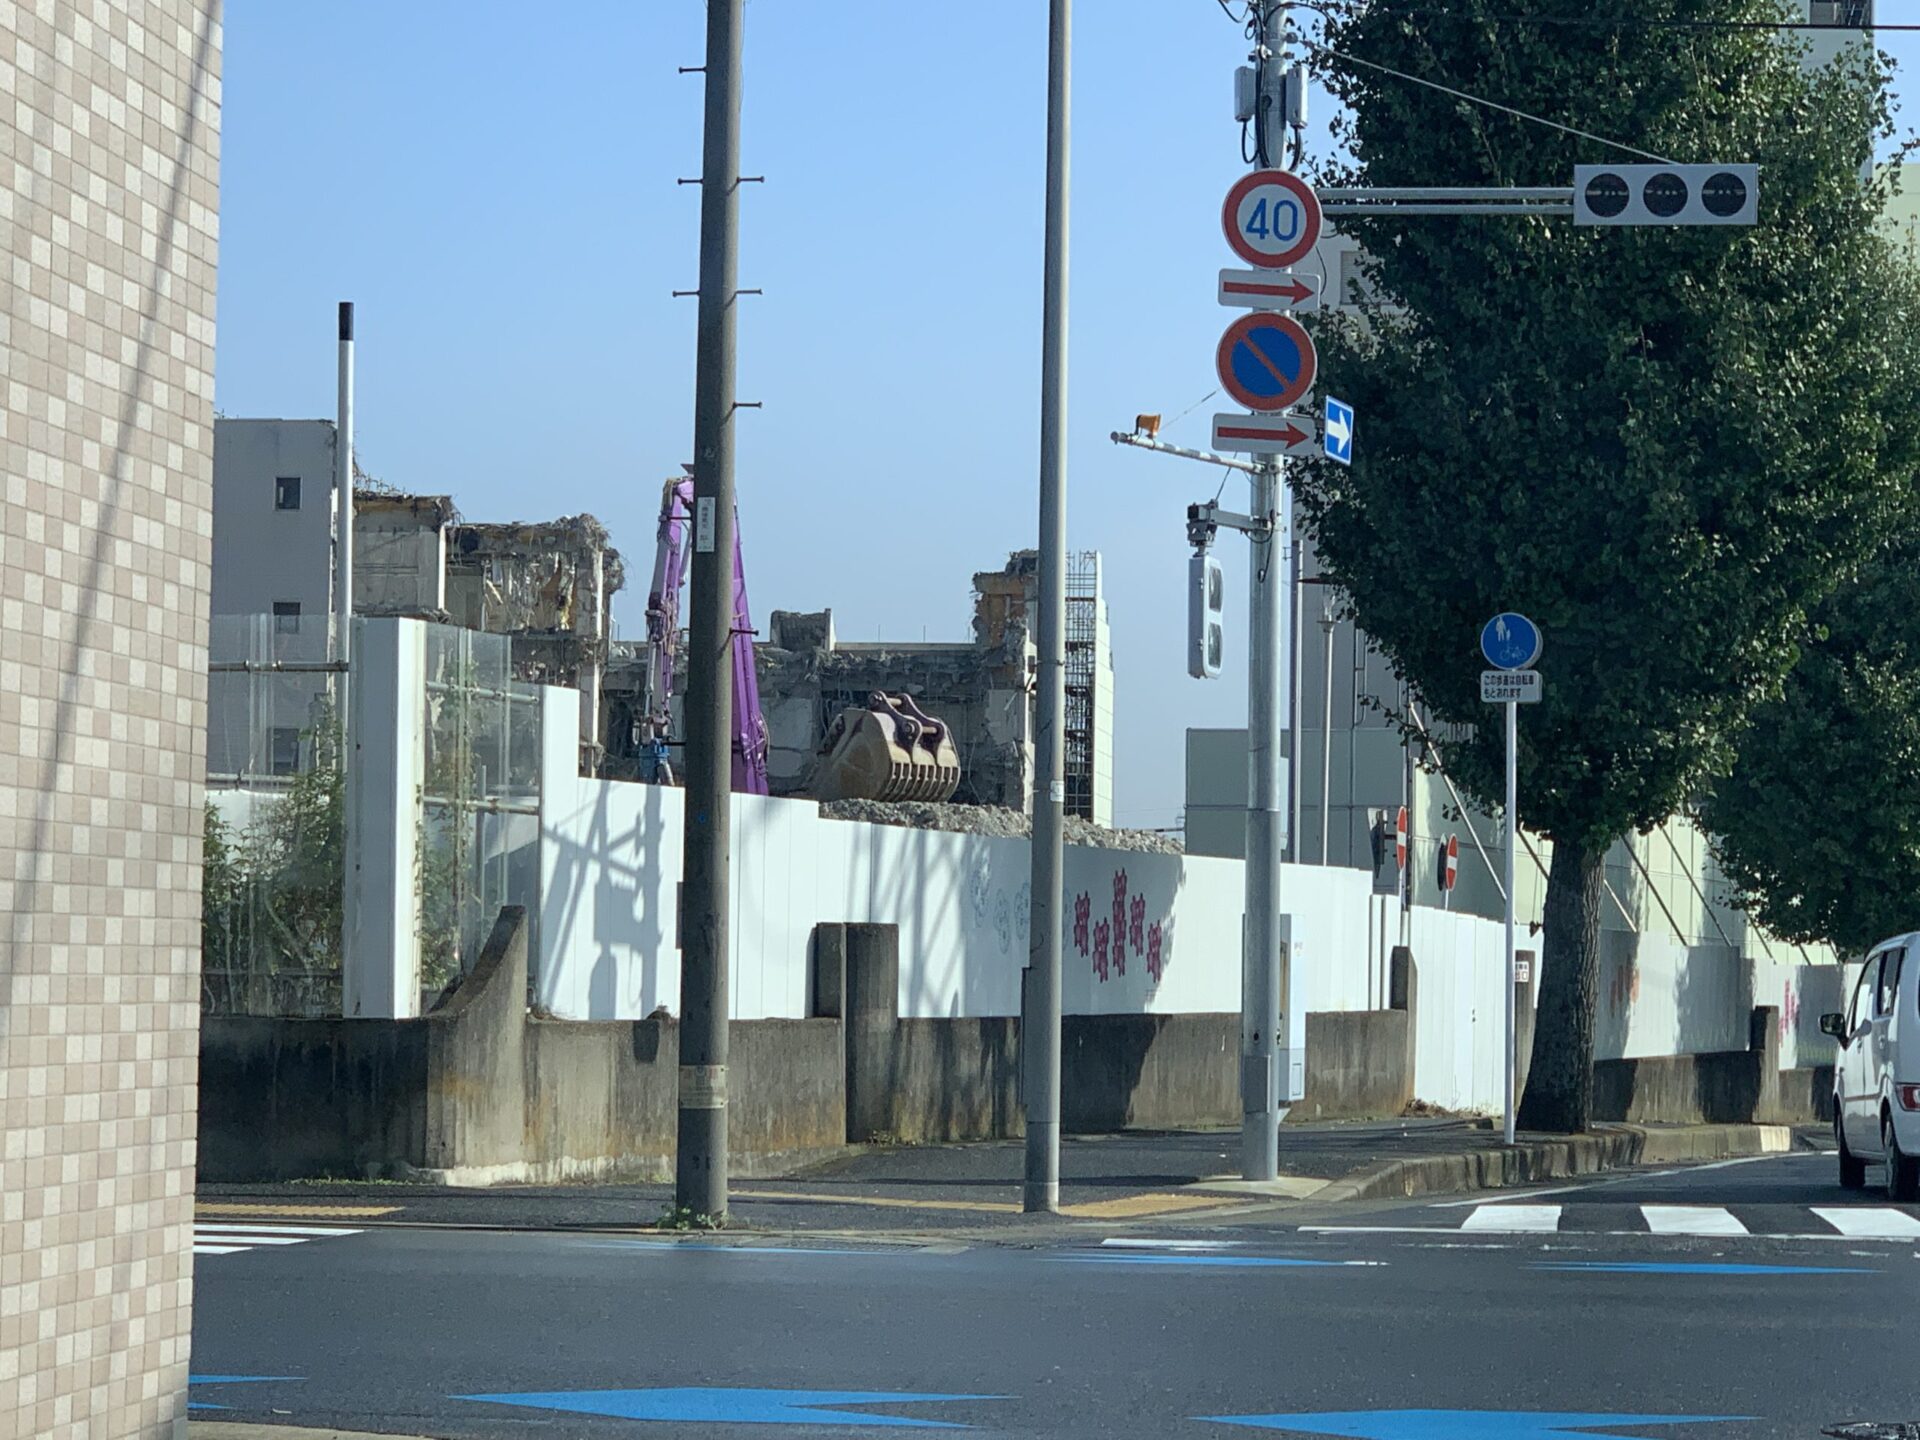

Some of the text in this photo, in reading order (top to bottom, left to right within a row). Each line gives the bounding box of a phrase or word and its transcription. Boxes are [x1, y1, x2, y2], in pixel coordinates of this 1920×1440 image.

[1246, 198, 1299, 241] 40
[1484, 687, 1522, 699] もとおれます
